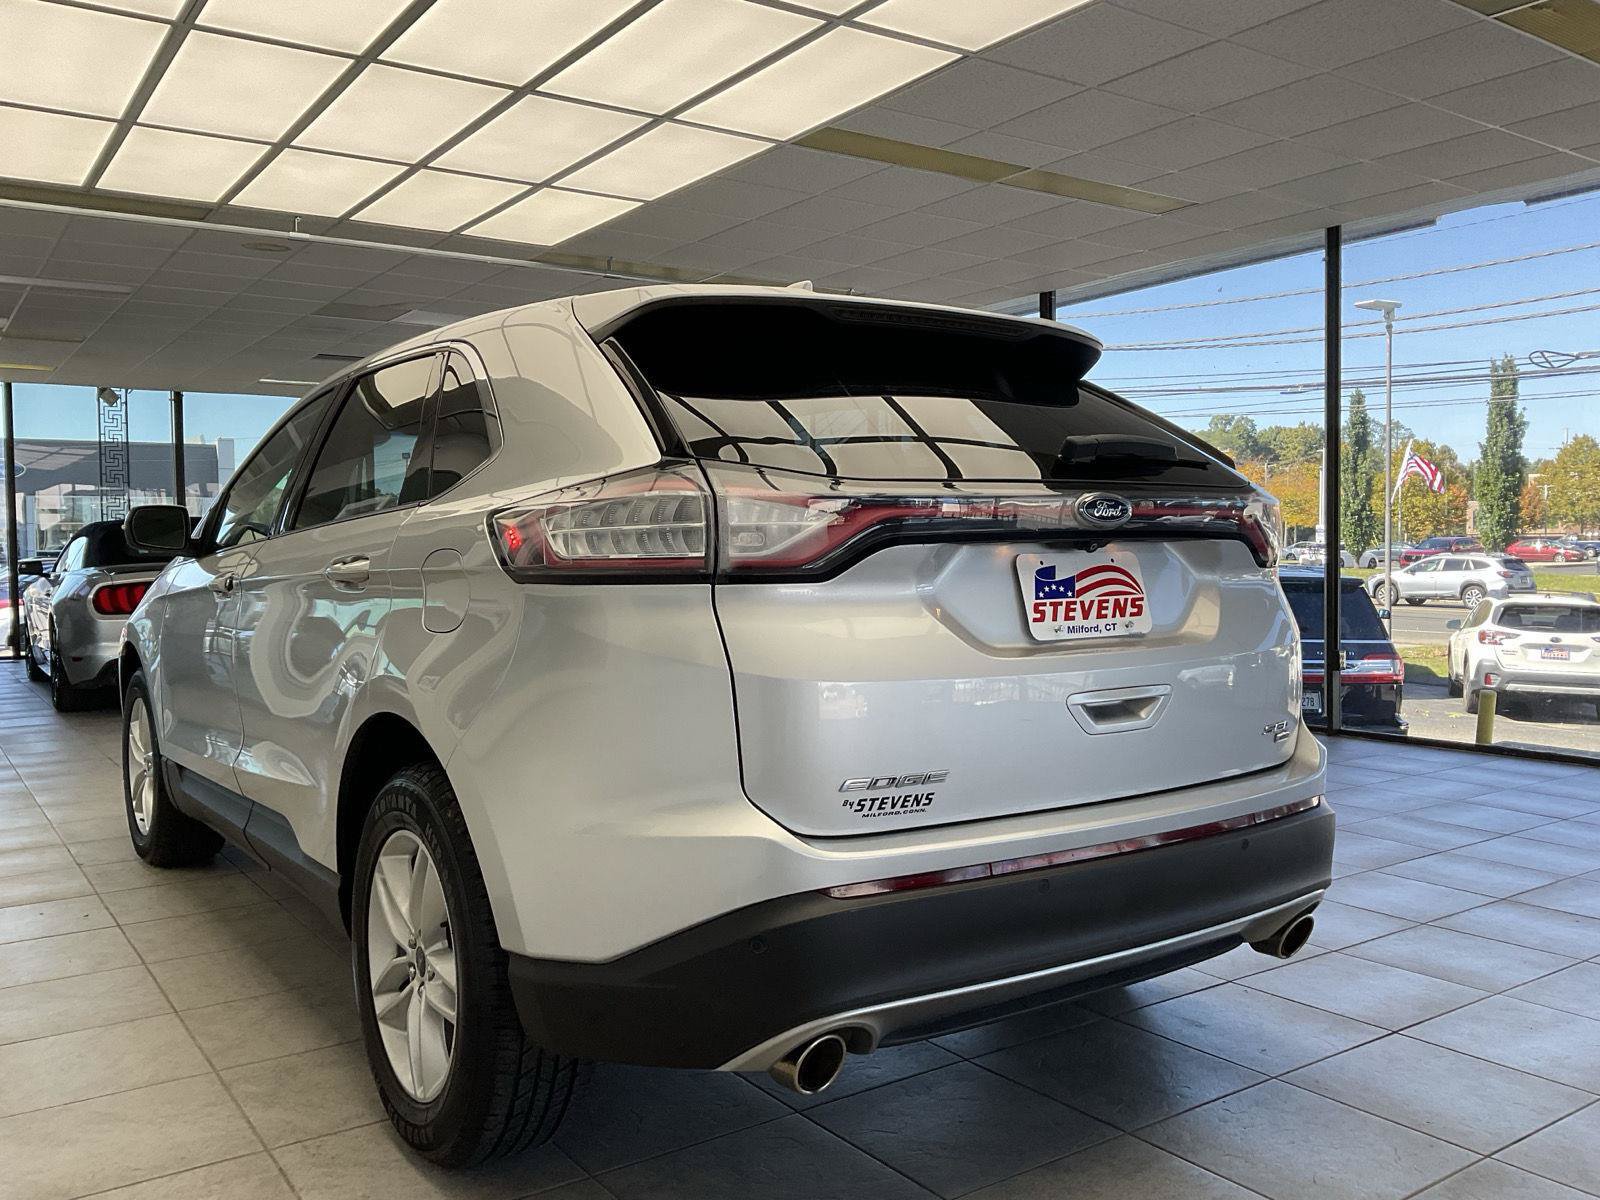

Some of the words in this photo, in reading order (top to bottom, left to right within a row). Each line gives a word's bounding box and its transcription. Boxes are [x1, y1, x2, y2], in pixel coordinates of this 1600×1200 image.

[1094, 500, 1122, 517] Ford
[1032, 597, 1144, 623] STEVENS
[1067, 624, 1102, 635] Milford,
[1104, 622, 1117, 632] CT
[838, 769, 950, 792] EDGE
[854, 792, 935, 813] STEVENS
